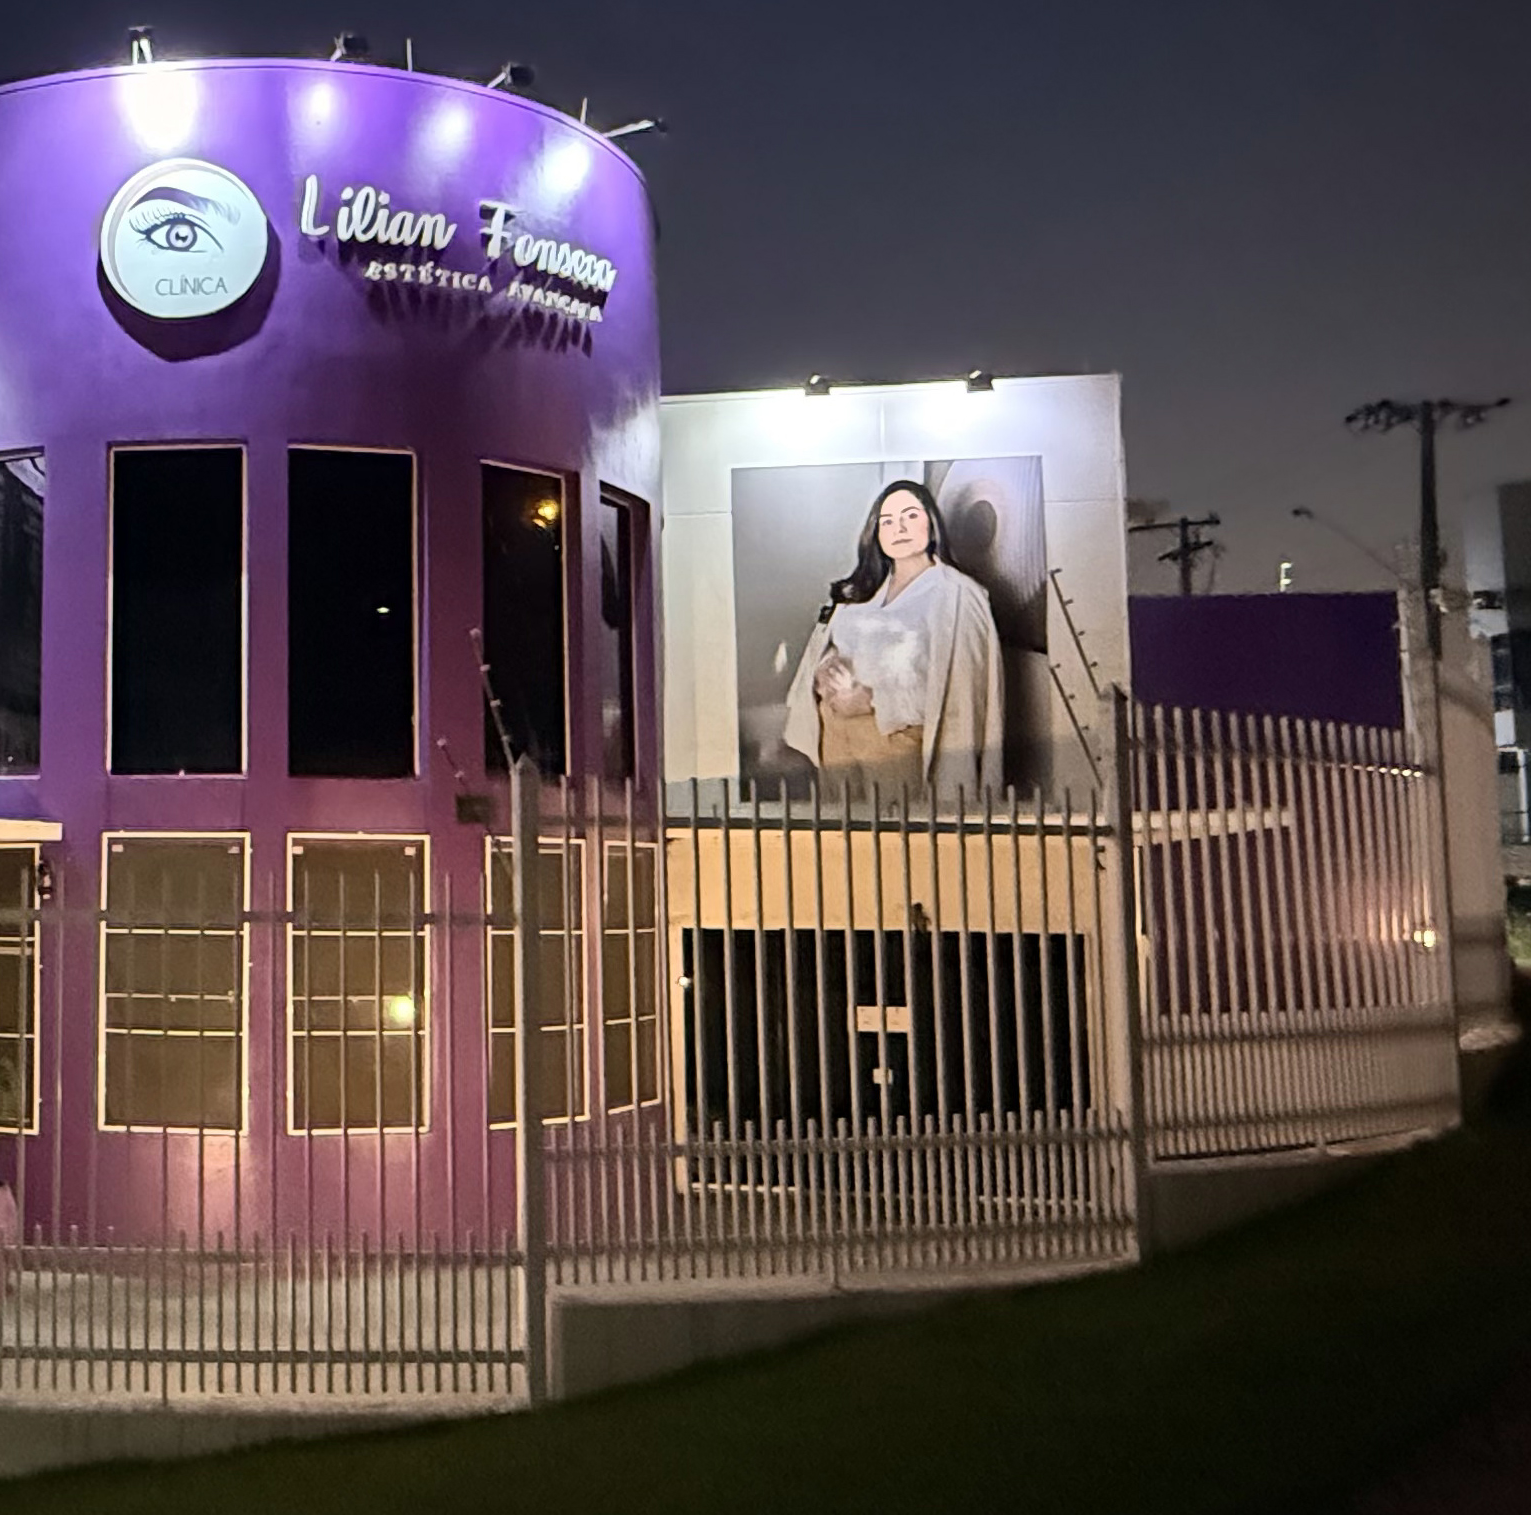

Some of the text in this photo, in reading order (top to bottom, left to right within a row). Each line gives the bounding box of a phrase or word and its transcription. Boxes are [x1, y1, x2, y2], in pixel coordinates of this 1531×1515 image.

[300, 174, 617, 293] Lilian Fonseca
[155, 274, 228, 296] CLÍNICA
[365, 259, 493, 293] ESTÉTICA
